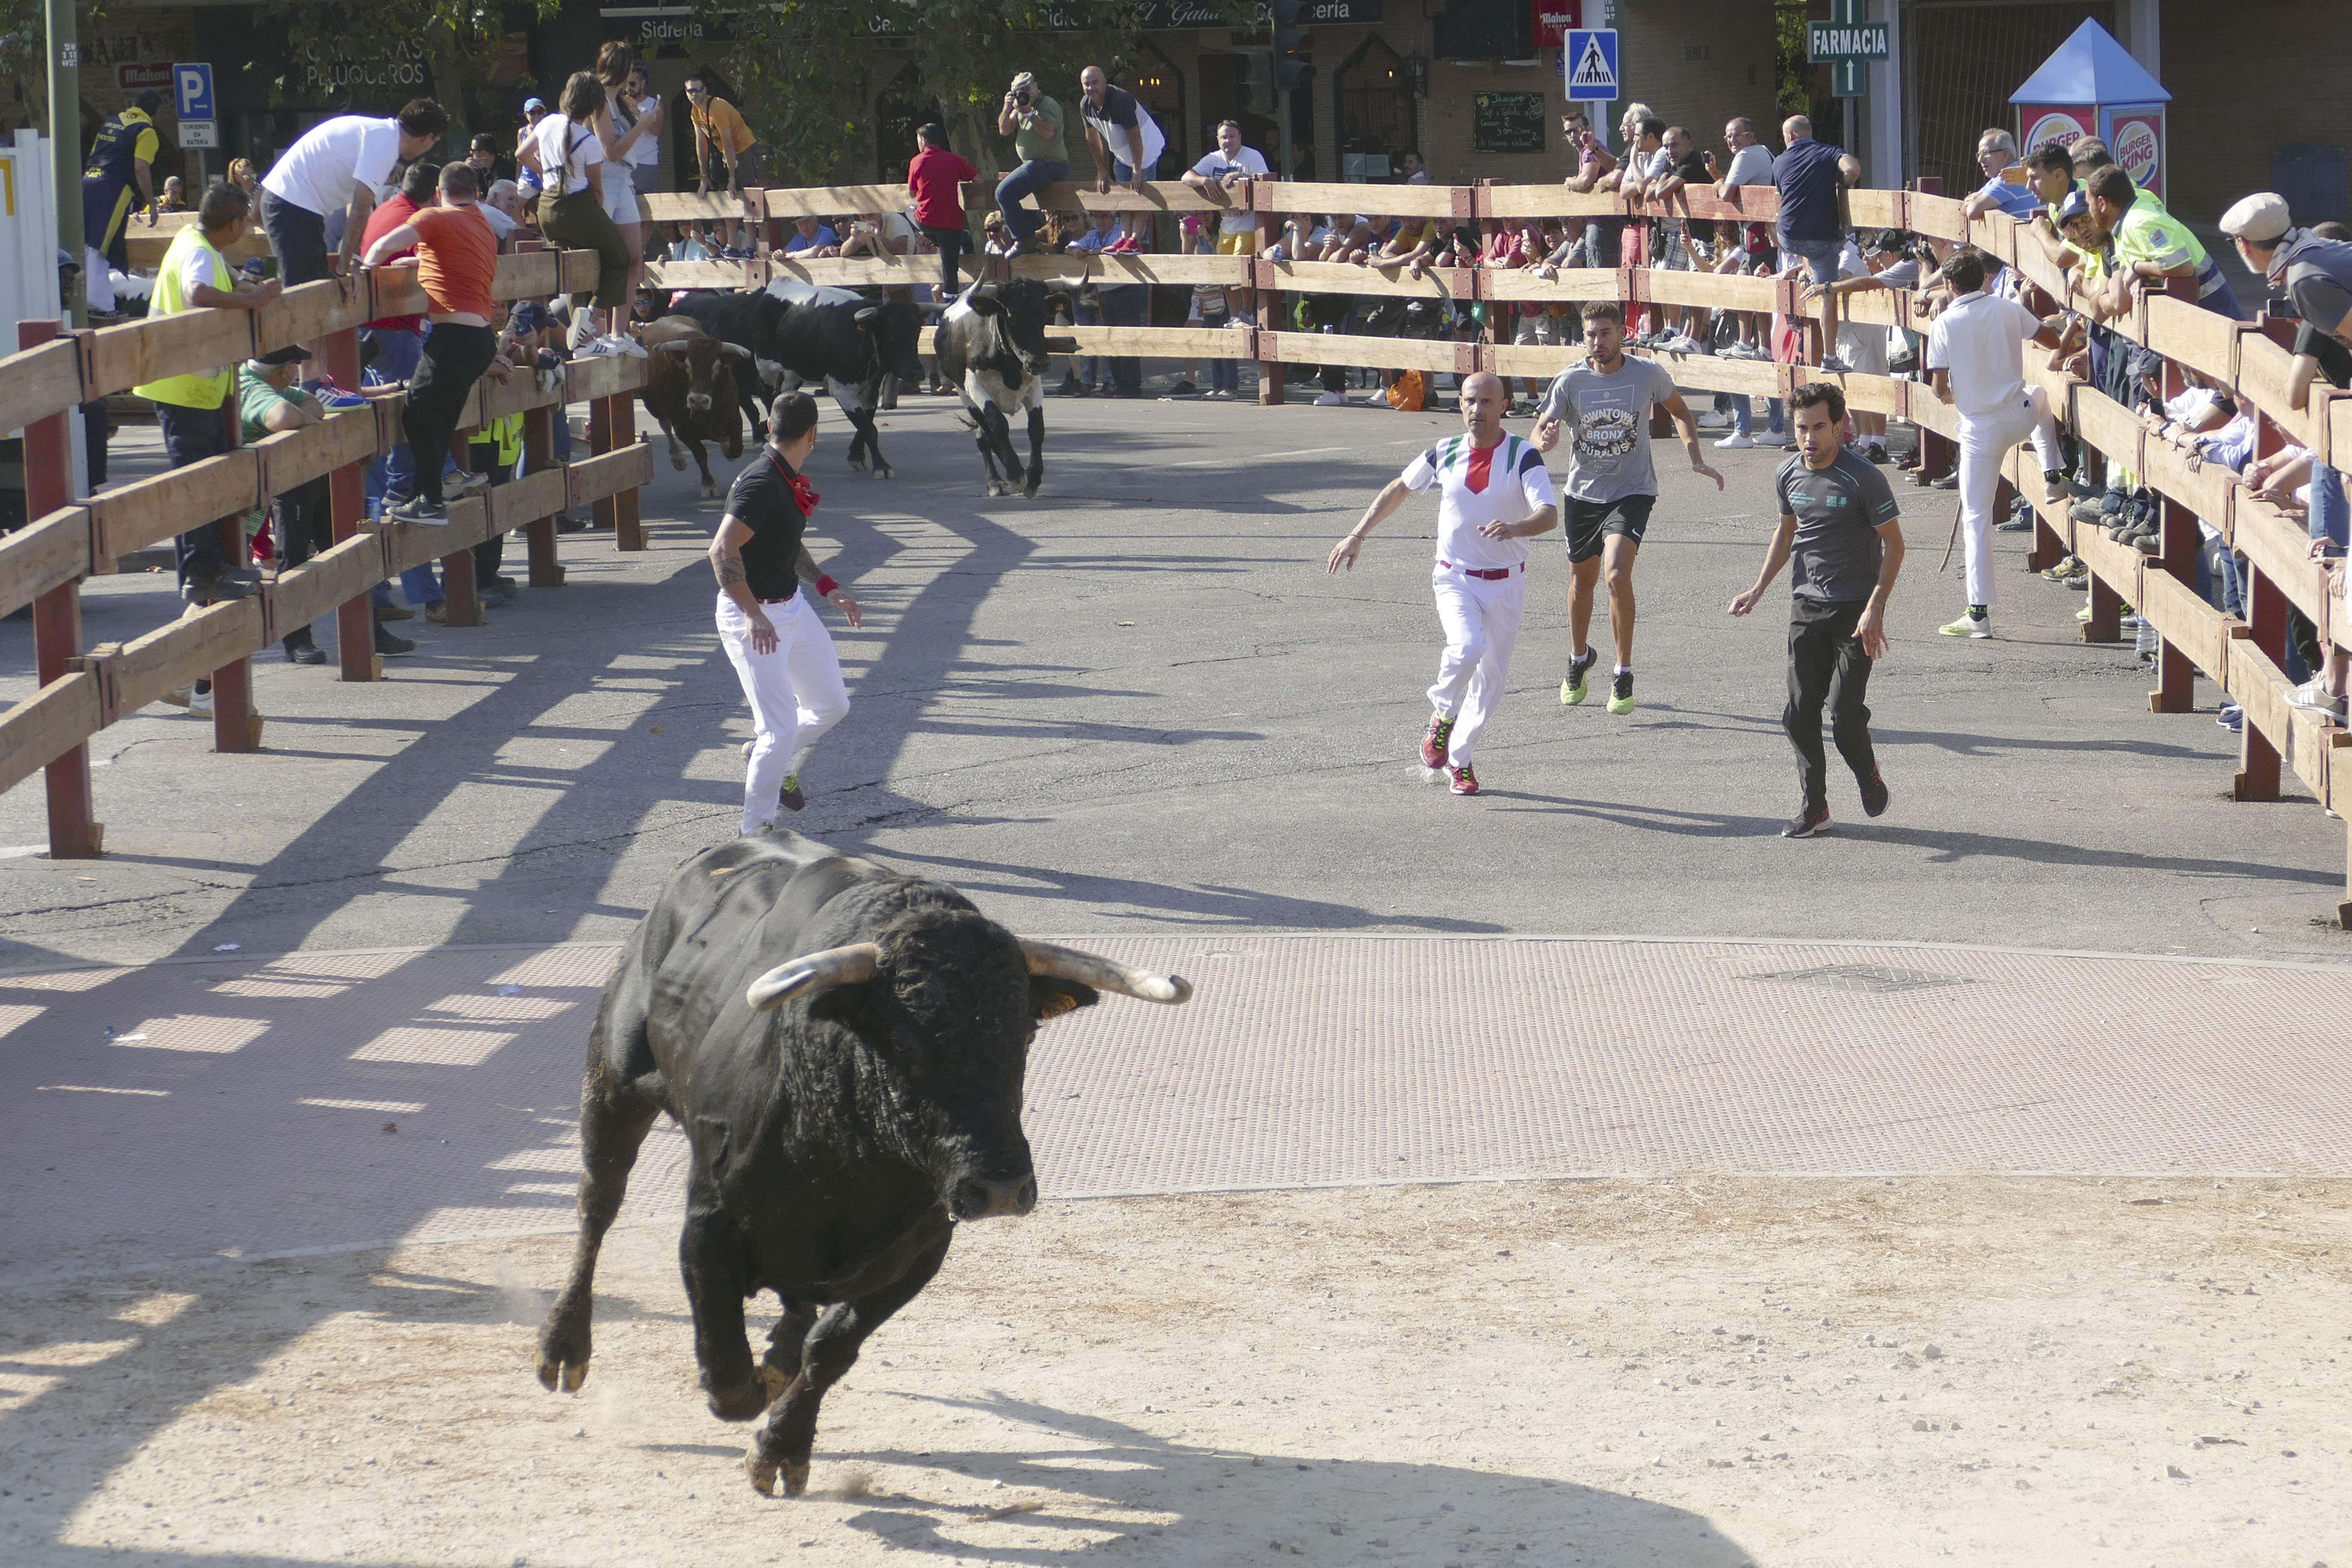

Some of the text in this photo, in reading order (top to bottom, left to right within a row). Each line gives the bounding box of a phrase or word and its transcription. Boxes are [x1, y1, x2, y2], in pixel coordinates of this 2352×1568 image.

[1542, 12, 1571, 23] Mahou
[1813, 28, 1886, 55] FARMACIA
[125, 67, 171, 83] Mahou
[181, 71, 204, 113] P
[2120, 133, 2151, 159] BURGER
[2122, 144, 2153, 172] KING
[1586, 430, 1624, 440] BRONX
[1580, 441, 1629, 458] SURPLUS
